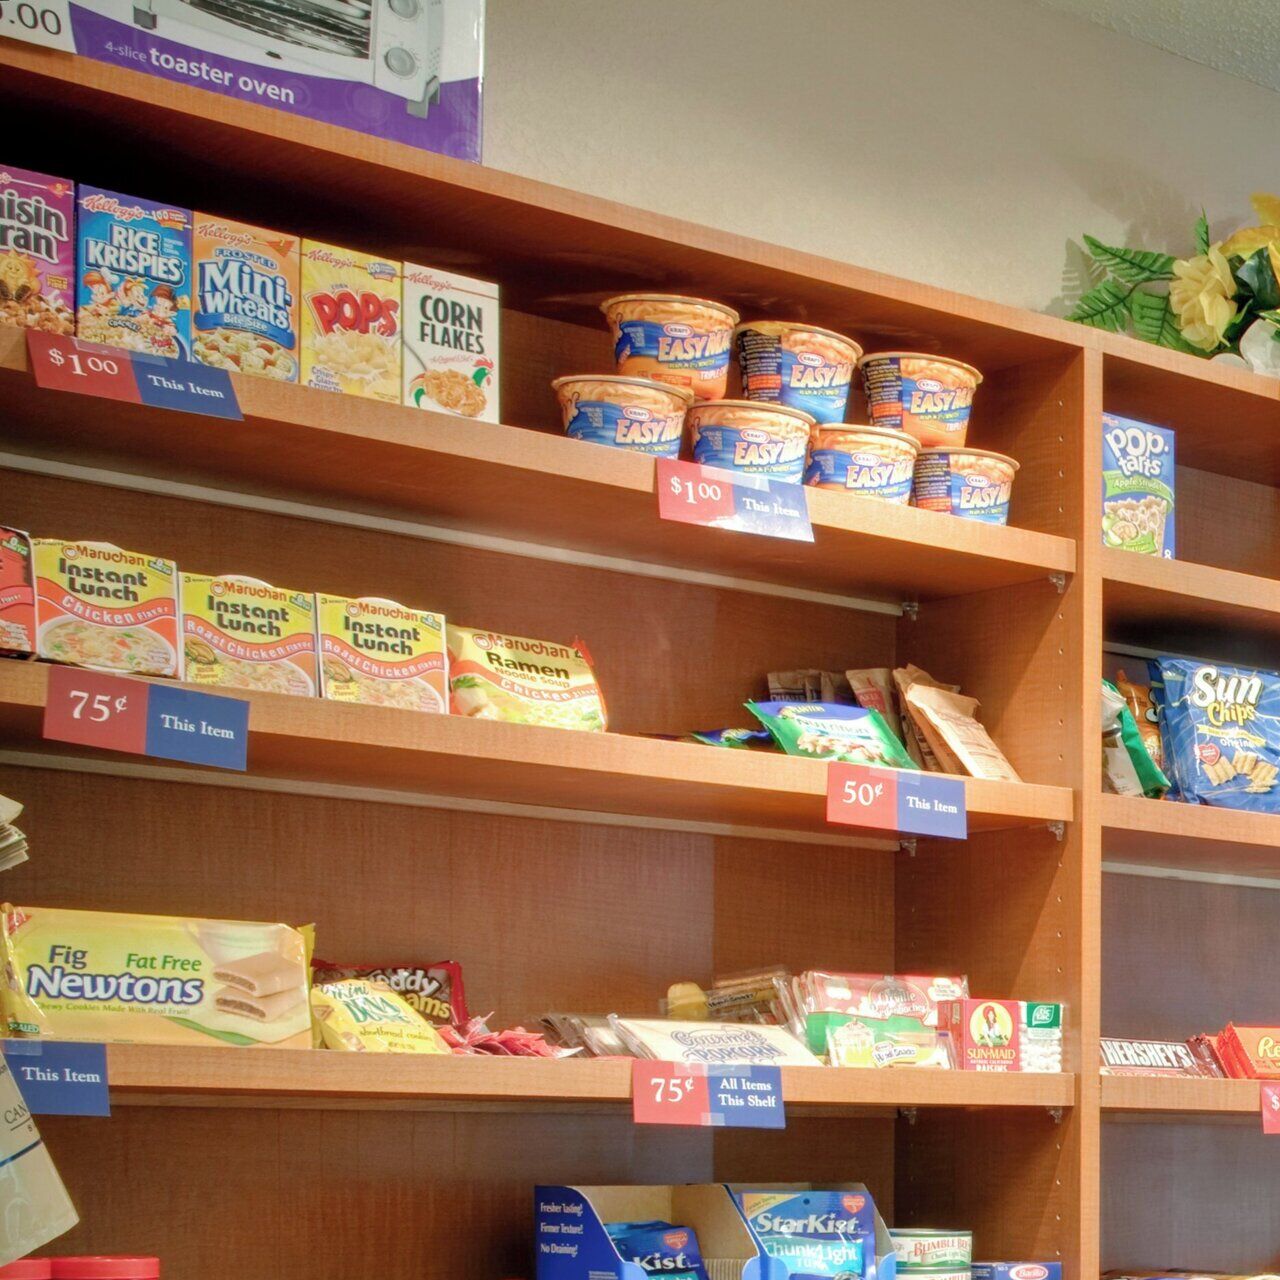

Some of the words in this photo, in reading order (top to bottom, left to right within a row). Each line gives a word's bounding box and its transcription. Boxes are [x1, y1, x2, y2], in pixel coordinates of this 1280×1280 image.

[104, 40, 147, 64] 4-slice
[149, 46, 234, 88] toaster
[237, 77, 296, 105] oven
[110, 224, 160, 253] RICE
[86, 239, 184, 285] KRISPIES
[214, 248, 278, 270] FROSTED
[202, 290, 290, 331] Wheats
[309, 288, 399, 338] POPS
[419, 294, 483, 333] CORN
[419, 321, 485, 356] FLAKES
[657, 336, 707, 363] EASY
[148, 374, 185, 392] This
[187, 382, 225, 399] Item
[789, 363, 838, 389] EASY
[909, 390, 956, 415] EASY
[614, 418, 662, 445] EASY
[734, 440, 785, 467] EASY
[1118, 454, 1163, 477] tarts
[845, 464, 894, 489] EASY
[743, 497, 771, 515] This
[76, 544, 146, 568] Maruchan
[58, 557, 148, 588] Instant
[68, 576, 140, 602] Lunch
[223, 580, 288, 602] Maruchan
[62, 595, 135, 625] Chicken
[207, 594, 290, 623] Instant
[358, 601, 419, 623] Maruchan
[216, 612, 282, 638] Lunch
[343, 616, 421, 642] Instant
[226, 642, 285, 661] Chicken
[353, 632, 414, 656] Lunch
[485, 650, 570, 681] Ramen
[500, 676, 570, 699] Chicken
[1192, 664, 1263, 708] Sun
[69, 689, 128, 722] 75¢
[1206, 701, 1256, 726] Chips
[161, 713, 196, 733] This
[200, 721, 236, 740] Item
[842, 780, 884, 806] 50¢
[906, 795, 931, 811] This
[934, 799, 958, 814] Item
[48, 944, 89, 970] Fig
[126, 952, 157, 970] Fat
[161, 954, 203, 972] Free
[27, 964, 205, 1005] Newtons
[967, 1047, 1016, 1060] SUN-MAID
[1105, 1041, 1191, 1067] HERSHEY'S
[21, 1066, 60, 1083] This
[63, 1067, 101, 1085] Item
[719, 1078, 738, 1091] All
[741, 1078, 773, 1092] Items
[650, 1077, 694, 1103] 75¢
[718, 1093, 744, 1107] This
[747, 1094, 777, 1109] Shelf
[755, 1212, 860, 1235] StarKist
